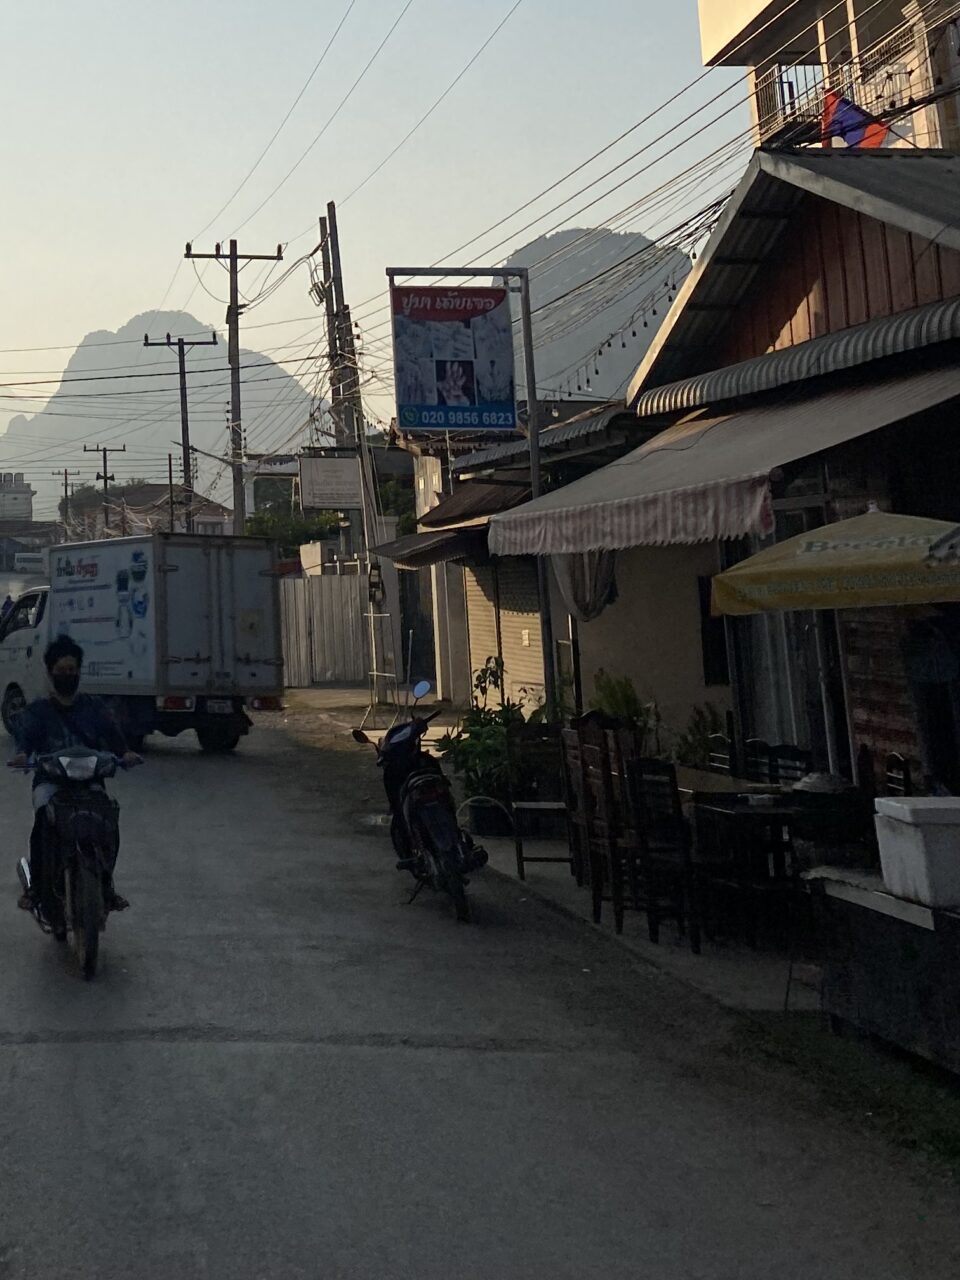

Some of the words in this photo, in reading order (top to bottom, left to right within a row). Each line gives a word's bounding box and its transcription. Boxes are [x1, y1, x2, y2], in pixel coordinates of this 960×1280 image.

[421, 411, 444, 424] 020
[448, 411, 479, 425] 9856
[482, 411, 513, 425] 6823
[800, 535, 929, 553] Beerla
